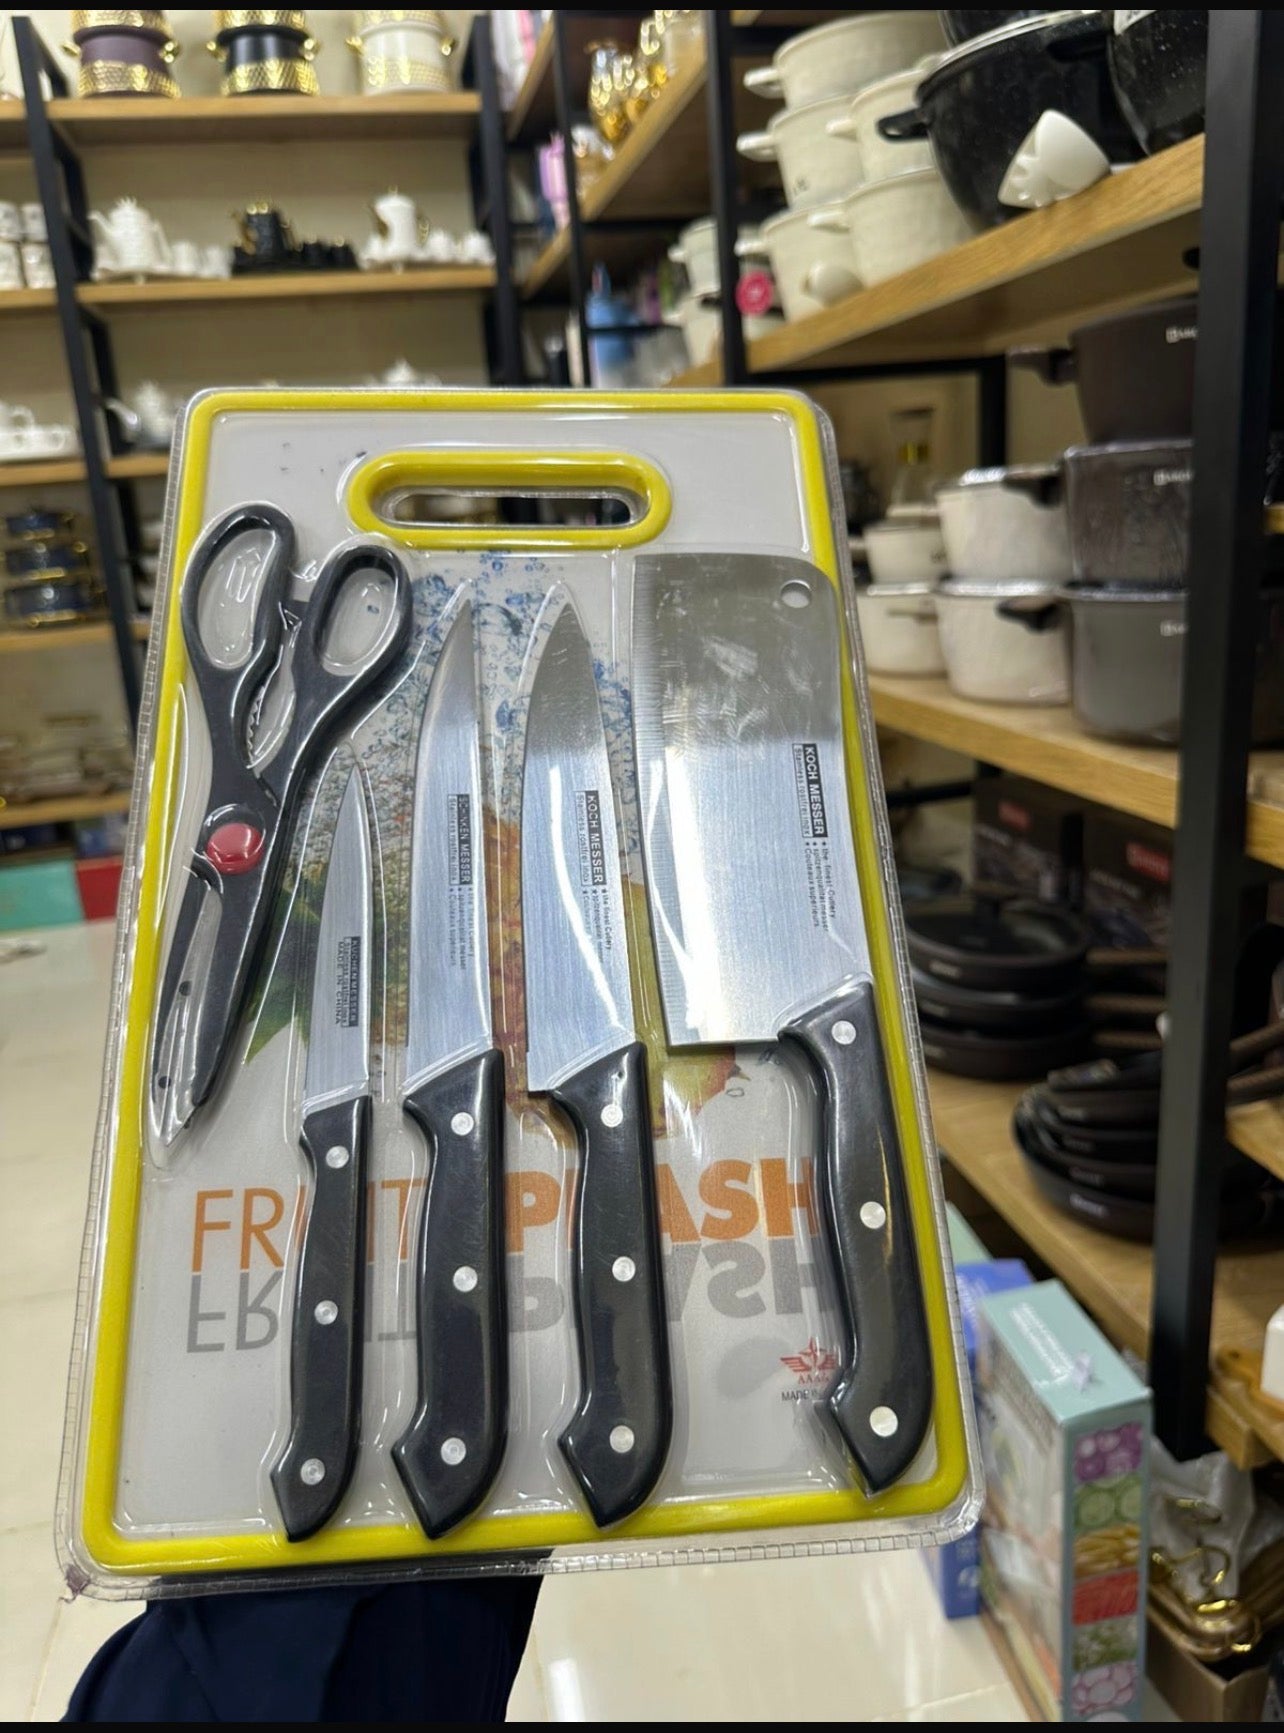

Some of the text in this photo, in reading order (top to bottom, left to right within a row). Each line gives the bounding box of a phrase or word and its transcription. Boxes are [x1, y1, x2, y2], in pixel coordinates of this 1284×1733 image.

[805, 746, 825, 834] KOCH MESSER
[587, 795, 603, 883] KOCH MESSER
[460, 844, 471, 882] MESSER
[336, 941, 344, 969] MADE
[336, 975, 342, 985] IN
[781, 1390, 809, 1401] MADE
